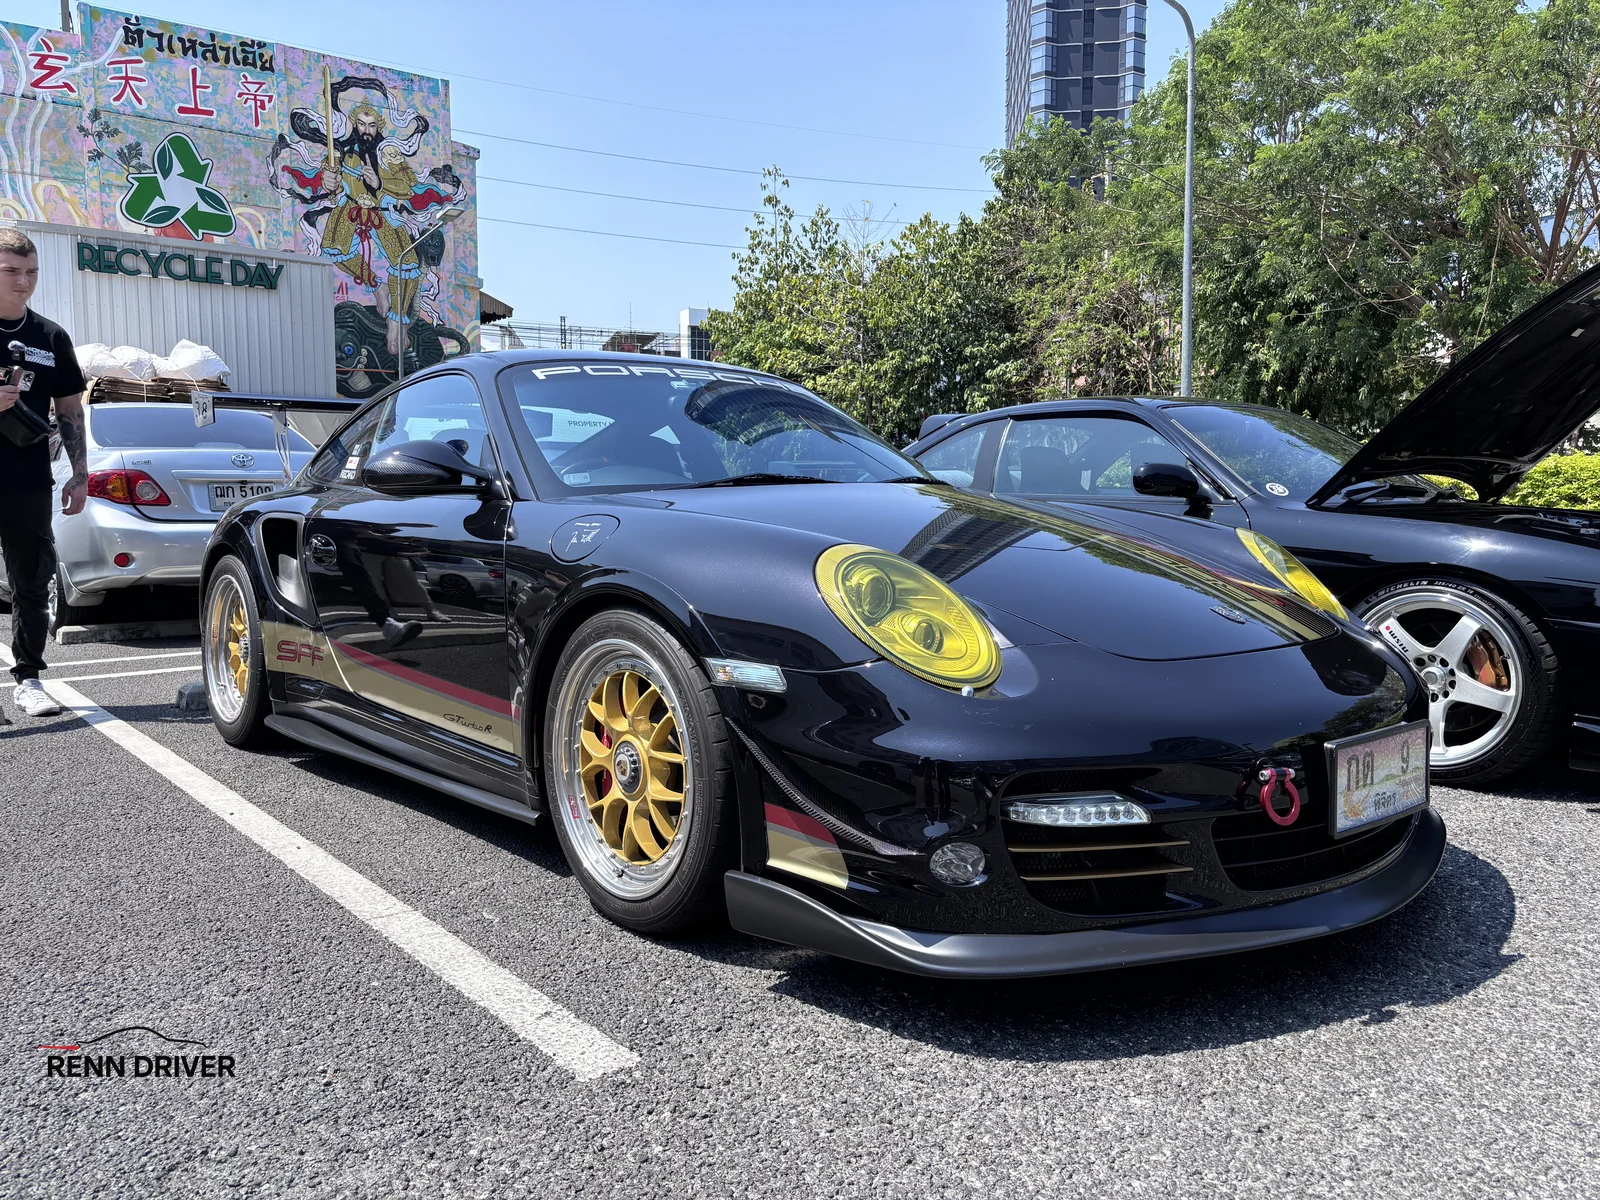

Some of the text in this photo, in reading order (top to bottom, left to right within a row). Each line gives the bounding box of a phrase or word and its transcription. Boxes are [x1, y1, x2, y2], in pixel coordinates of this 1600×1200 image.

[77, 241, 285, 290] RECYCLE DAY
[1377, 580, 1429, 597] MICHELIN
[1400, 739, 1410, 775] 9
